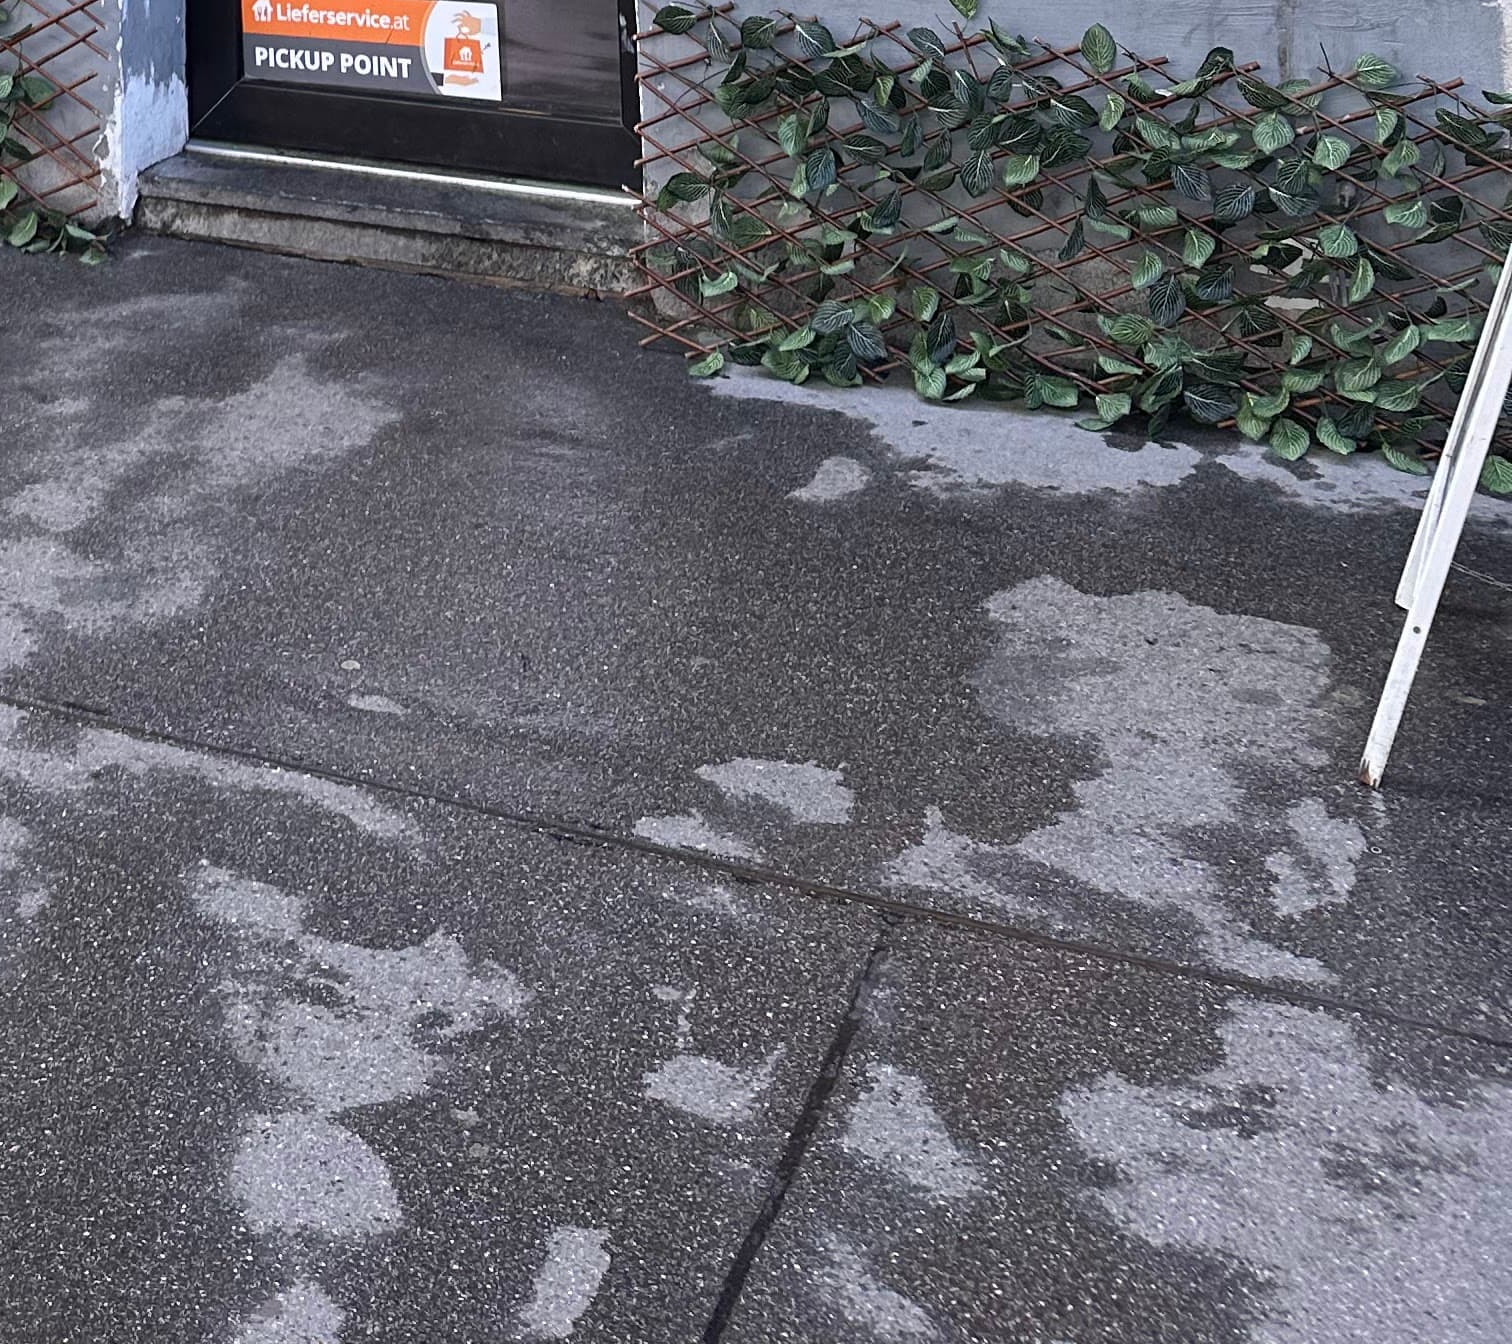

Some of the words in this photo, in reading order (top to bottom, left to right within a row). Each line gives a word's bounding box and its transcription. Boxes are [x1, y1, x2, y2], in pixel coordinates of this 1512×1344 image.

[276, 2, 410, 32] Lieferservice.at
[254, 46, 335, 72] PICKUP
[339, 52, 412, 79] POINT
